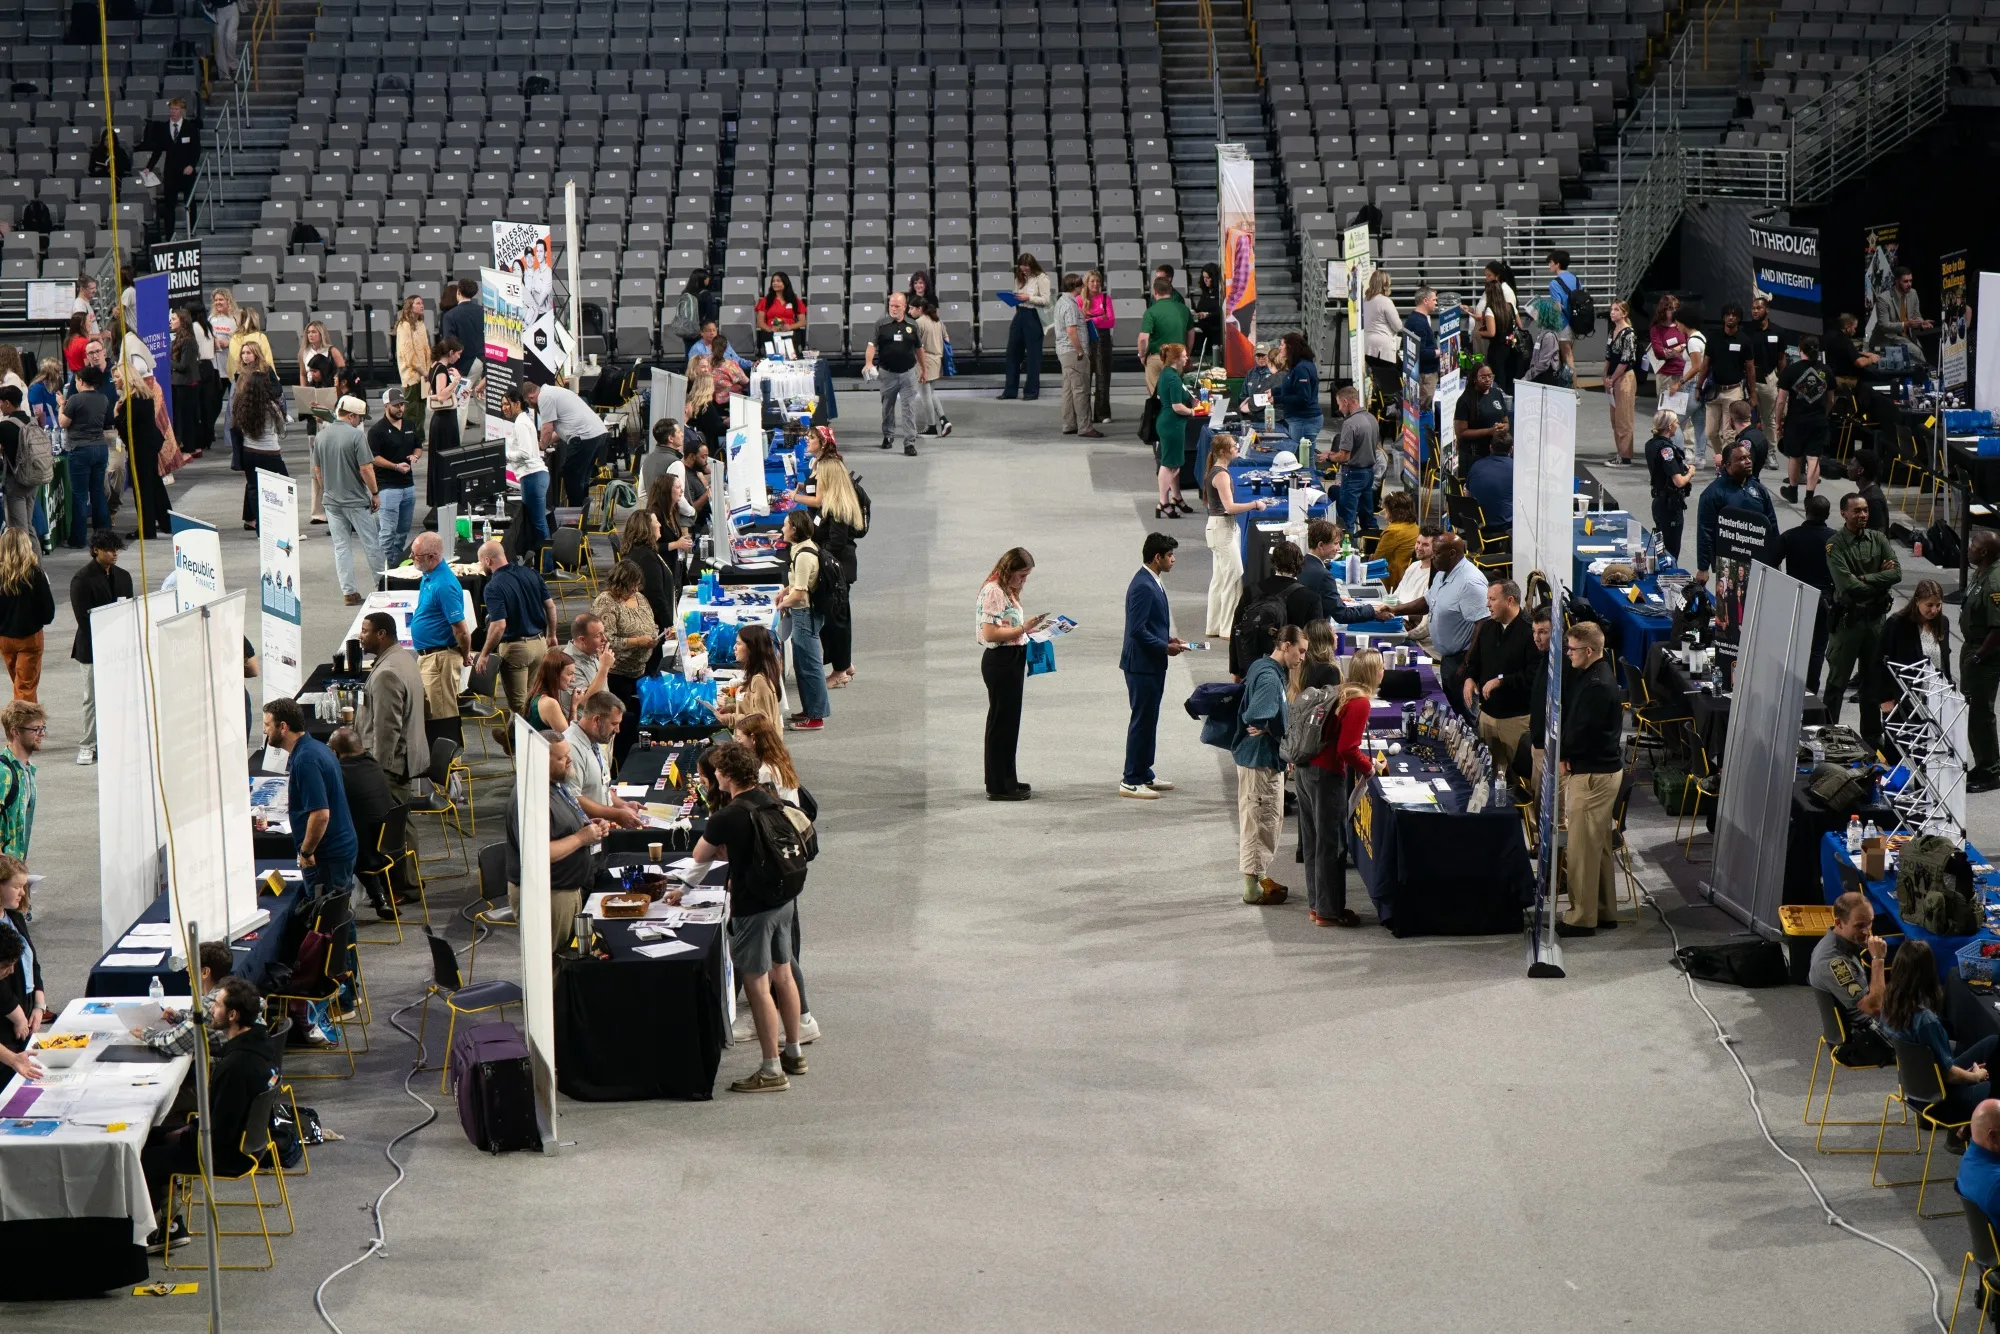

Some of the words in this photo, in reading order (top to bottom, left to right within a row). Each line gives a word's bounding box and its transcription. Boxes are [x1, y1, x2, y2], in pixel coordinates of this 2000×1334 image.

[496, 224, 534, 260] MARKETING
[497, 227, 518, 250] SALES
[497, 230, 539, 267] INTERNSHIPS
[1761, 231, 1816, 256] THROUGH
[154, 252, 175, 271] WE
[177, 249, 200, 268] ARE
[168, 269, 199, 290] IRING
[1761, 267, 1775, 283] AND
[1776, 270, 1814, 290] INTEGRITY
[142, 332, 166, 344] NATIONAL
[1718, 515, 1749, 531] Chesterfield
[1748, 522, 1766, 536] County
[1719, 527, 1735, 540] Police
[1735, 532, 1765, 547] Department
[183, 554, 216, 579] Republic
[195, 576, 216, 592] FINANCE
